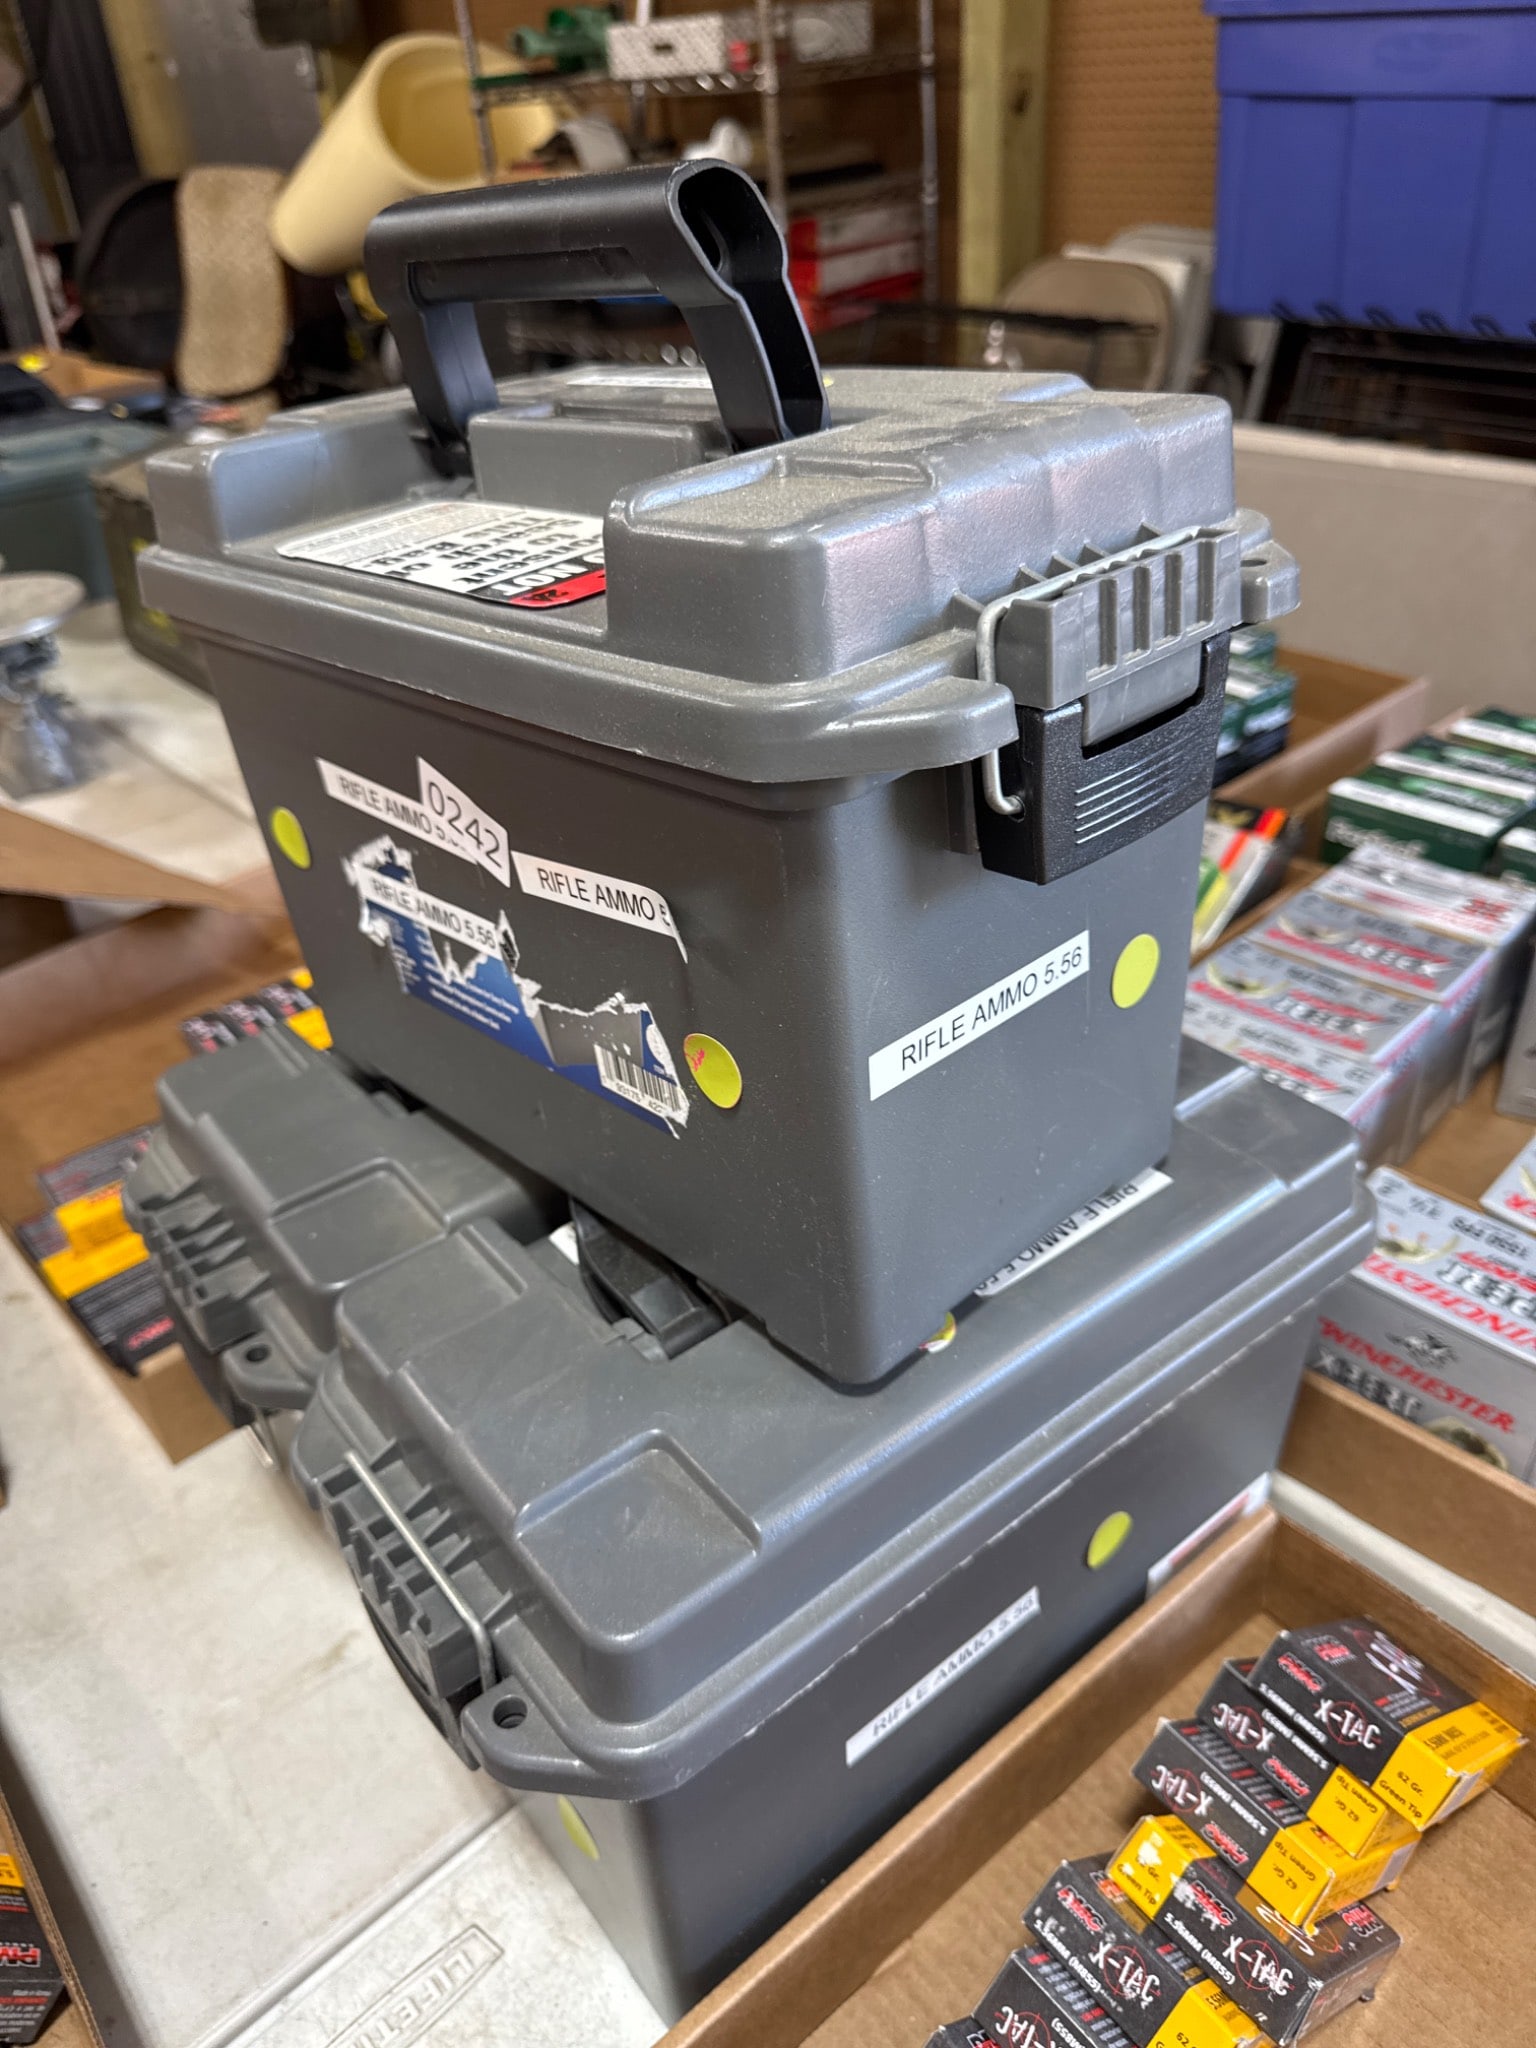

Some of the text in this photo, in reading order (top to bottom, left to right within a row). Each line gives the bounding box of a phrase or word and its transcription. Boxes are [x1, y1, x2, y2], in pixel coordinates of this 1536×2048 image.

[451, 548, 531, 572] the
[453, 534, 604, 585] onsent
[491, 563, 589, 597] NOT
[336, 775, 381, 812] RIFLE
[386, 797, 431, 836] AMMO
[428, 782, 503, 870] 0242
[372, 878, 497, 948] RIFLE AMMO 5.56
[537, 867, 587, 902] RIFLE
[595, 888, 655, 922] AMMO
[901, 946, 1083, 1072] RIFLE AMMO 5.56
[1362, 1253, 1536, 1352] INCHEST
[1317, 1315, 1514, 1433] WINCHESTER
[872, 1682, 930, 1737] RIFLE
[933, 1630, 995, 1686] AMMO
[1214, 1702, 1275, 1751] X-TAC
[1314, 1698, 1380, 1749] X-TAC
[1151, 1765, 1213, 1816] X-TAC
[1335, 1774, 1378, 1814] Green Tip
[1335, 1796, 1360, 1823] 62 Gr.
[1379, 1780, 1422, 1819] Green Tip
[1398, 1771, 1424, 1797] 62 Gr.
[1273, 1863, 1298, 1890] 62 Gr.
[1274, 1841, 1316, 1882] Green Tip
[1143, 1888, 1157, 1906] Tip
[1088, 1941, 1160, 2003] X-TAC
[1164, 1912, 1203, 1952] 5.56MM
[1201, 1949, 1236, 1985] (M855)
[1222, 1935, 1294, 1996] X-TAC
[352, 1950, 476, 2048] LIFETI
[1068, 1956, 1102, 1993] (M855)
[994, 2005, 1058, 2048] -TAC
